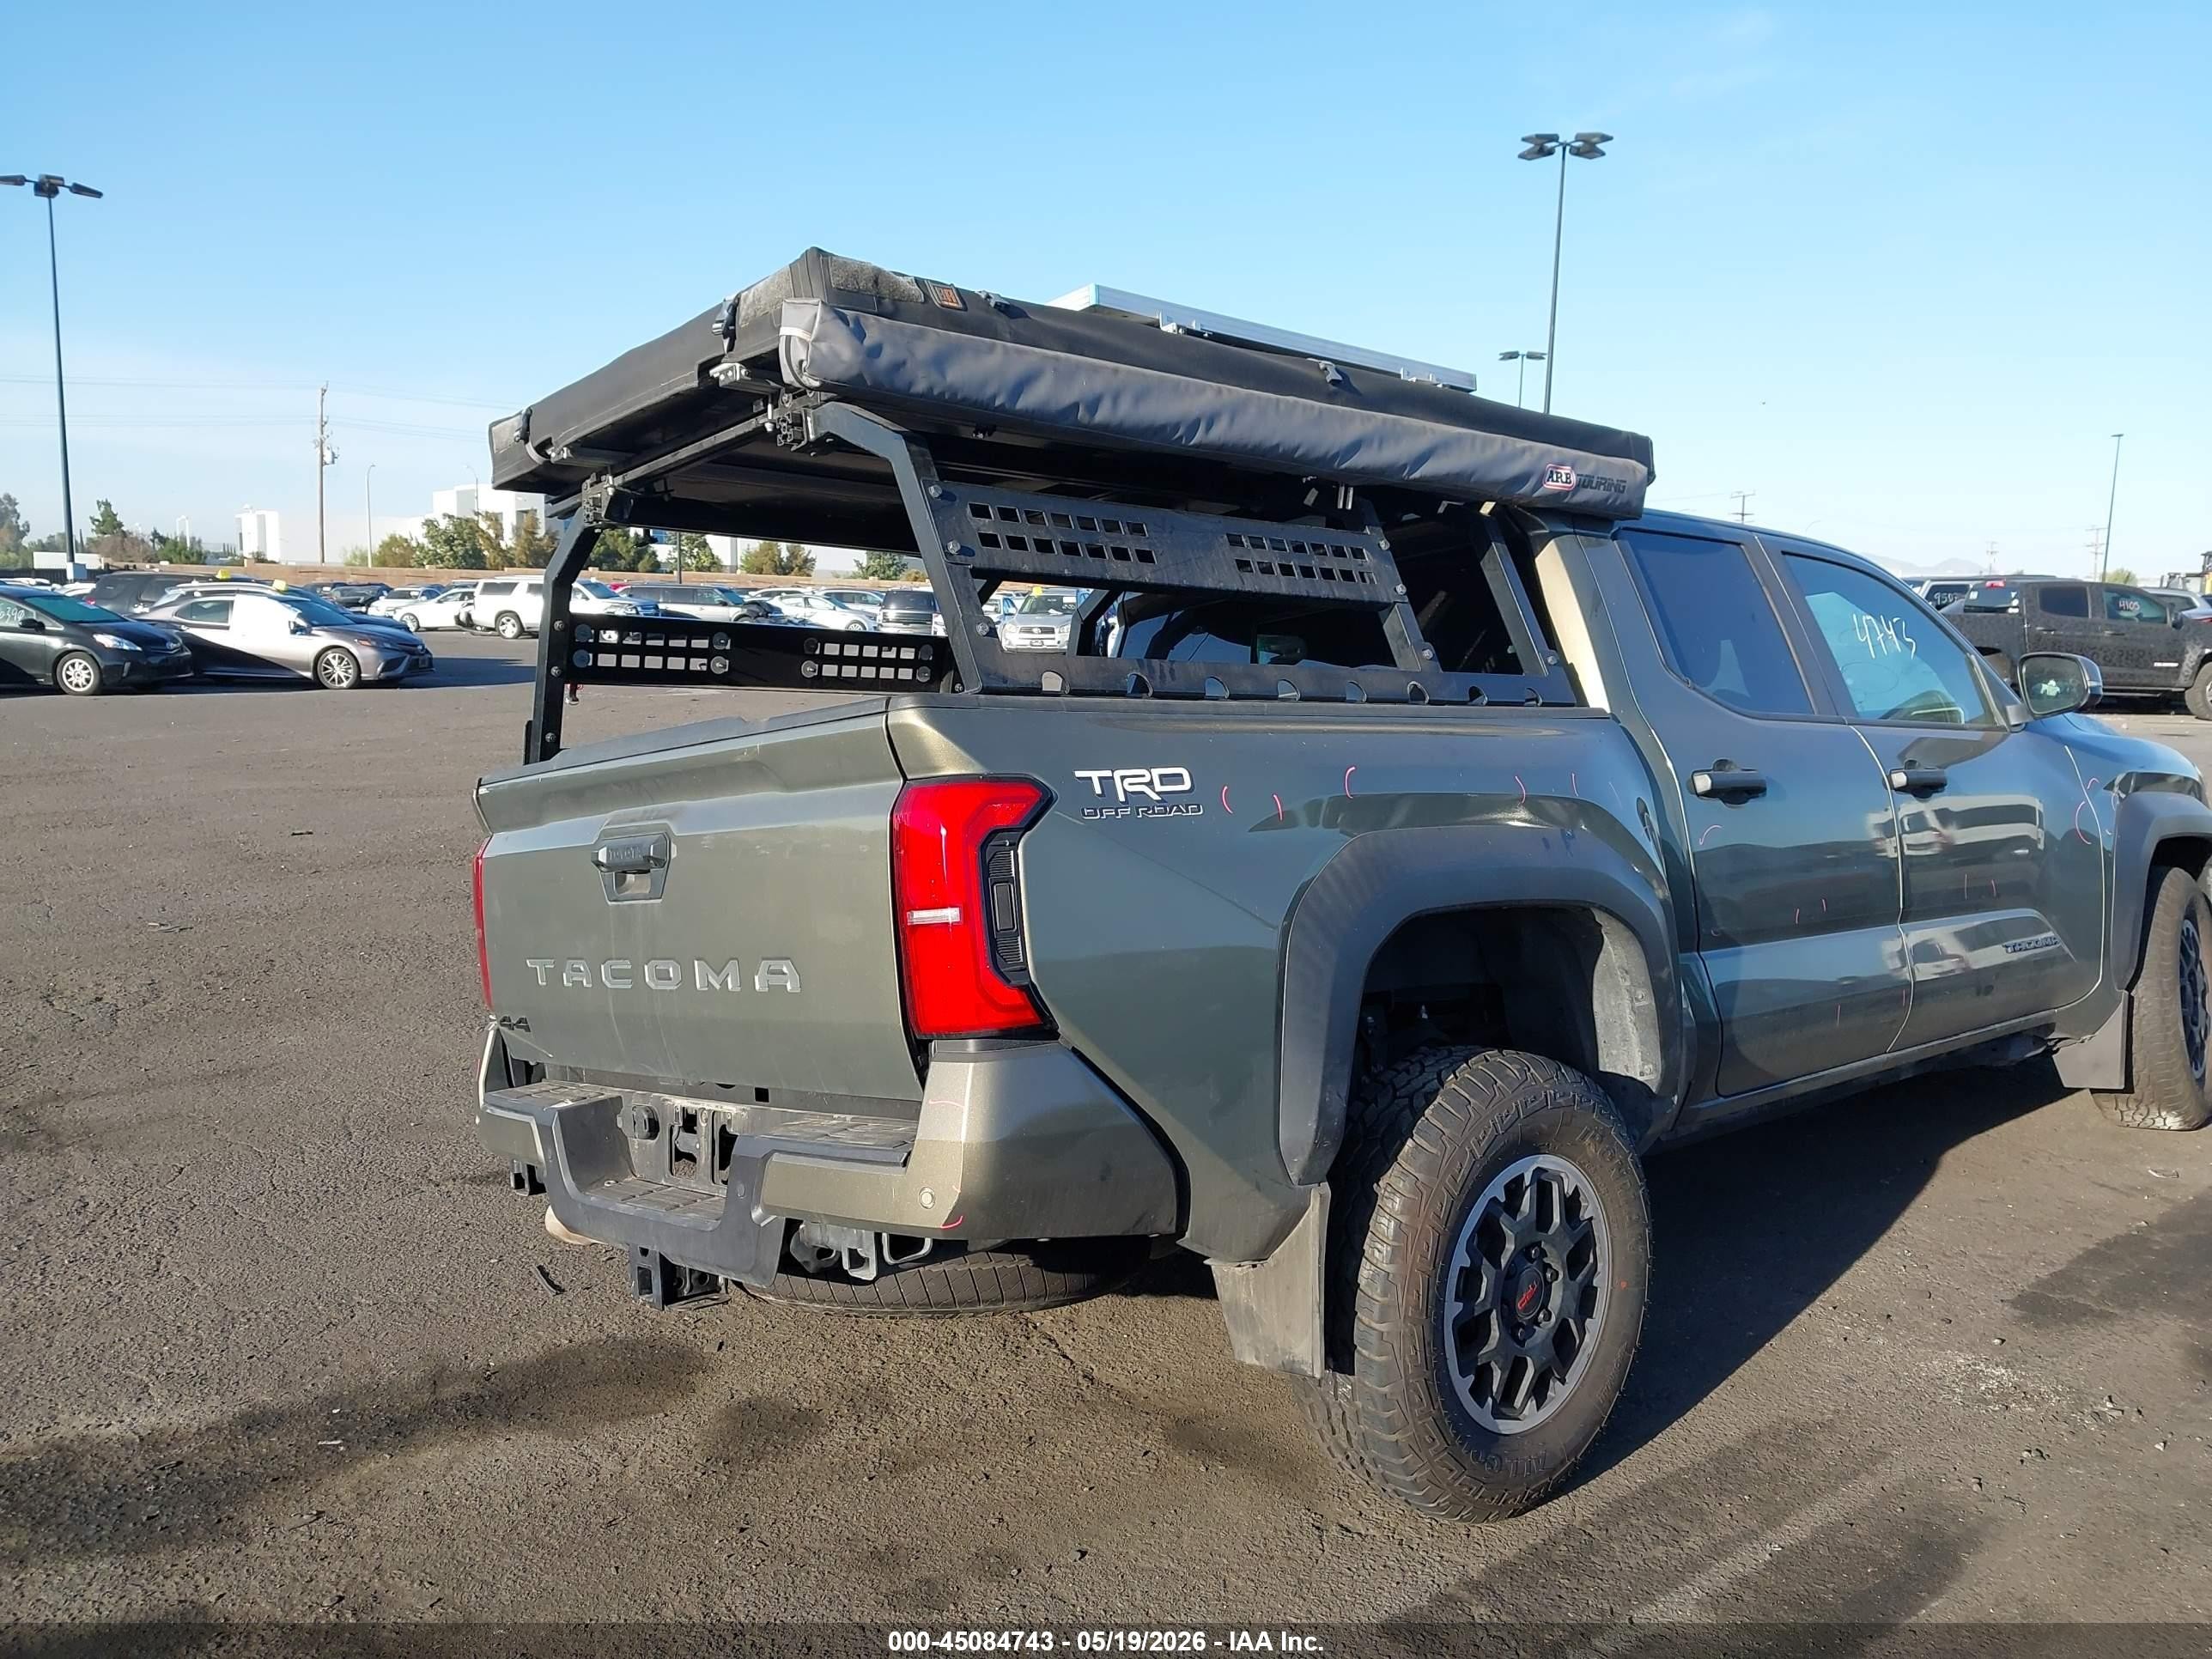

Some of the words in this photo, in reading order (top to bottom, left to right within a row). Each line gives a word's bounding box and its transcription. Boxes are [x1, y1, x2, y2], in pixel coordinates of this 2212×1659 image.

[1546, 468, 1573, 486] ARB
[1577, 473, 1627, 494] TOURING
[1852, 613, 1917, 660] 4743
[1073, 766, 1195, 805] TRD
[1080, 805, 1131, 820] OFF
[1136, 803, 1204, 819] ROAD
[526, 957, 802, 994] TACOMA
